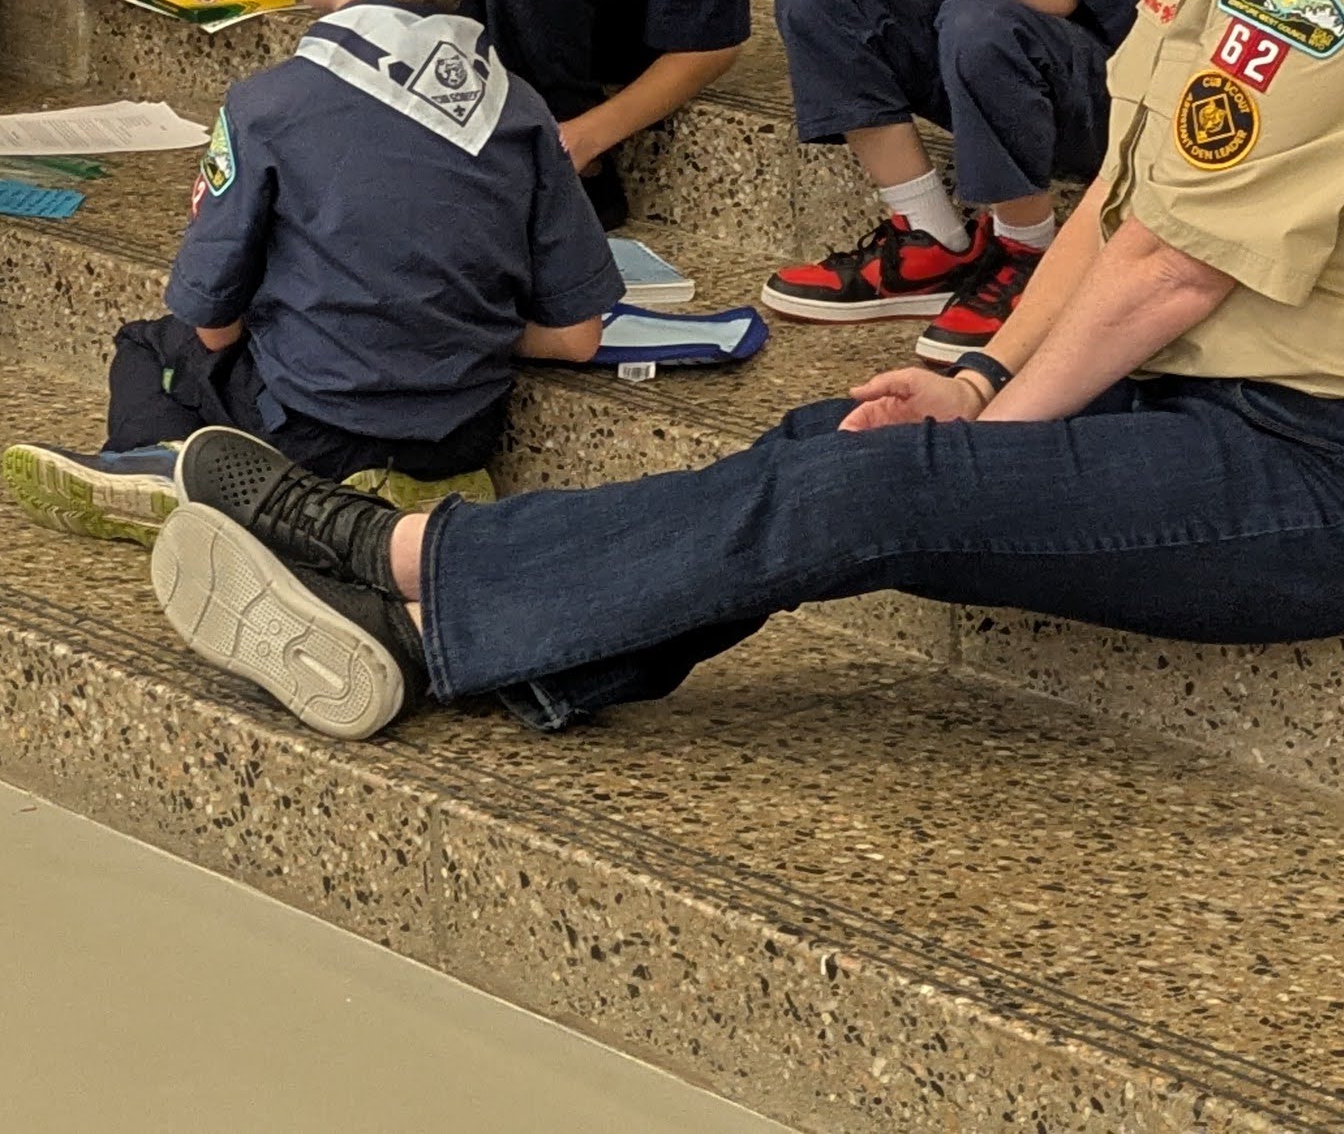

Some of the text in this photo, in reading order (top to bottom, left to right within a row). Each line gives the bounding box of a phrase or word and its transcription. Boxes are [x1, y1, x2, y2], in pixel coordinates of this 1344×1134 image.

[1220, 23, 1280, 83] 62
[1203, 76, 1250, 113] CUB SCOUT
[1191, 145, 1213, 160] DEN
[1214, 129, 1248, 160] LEADER
